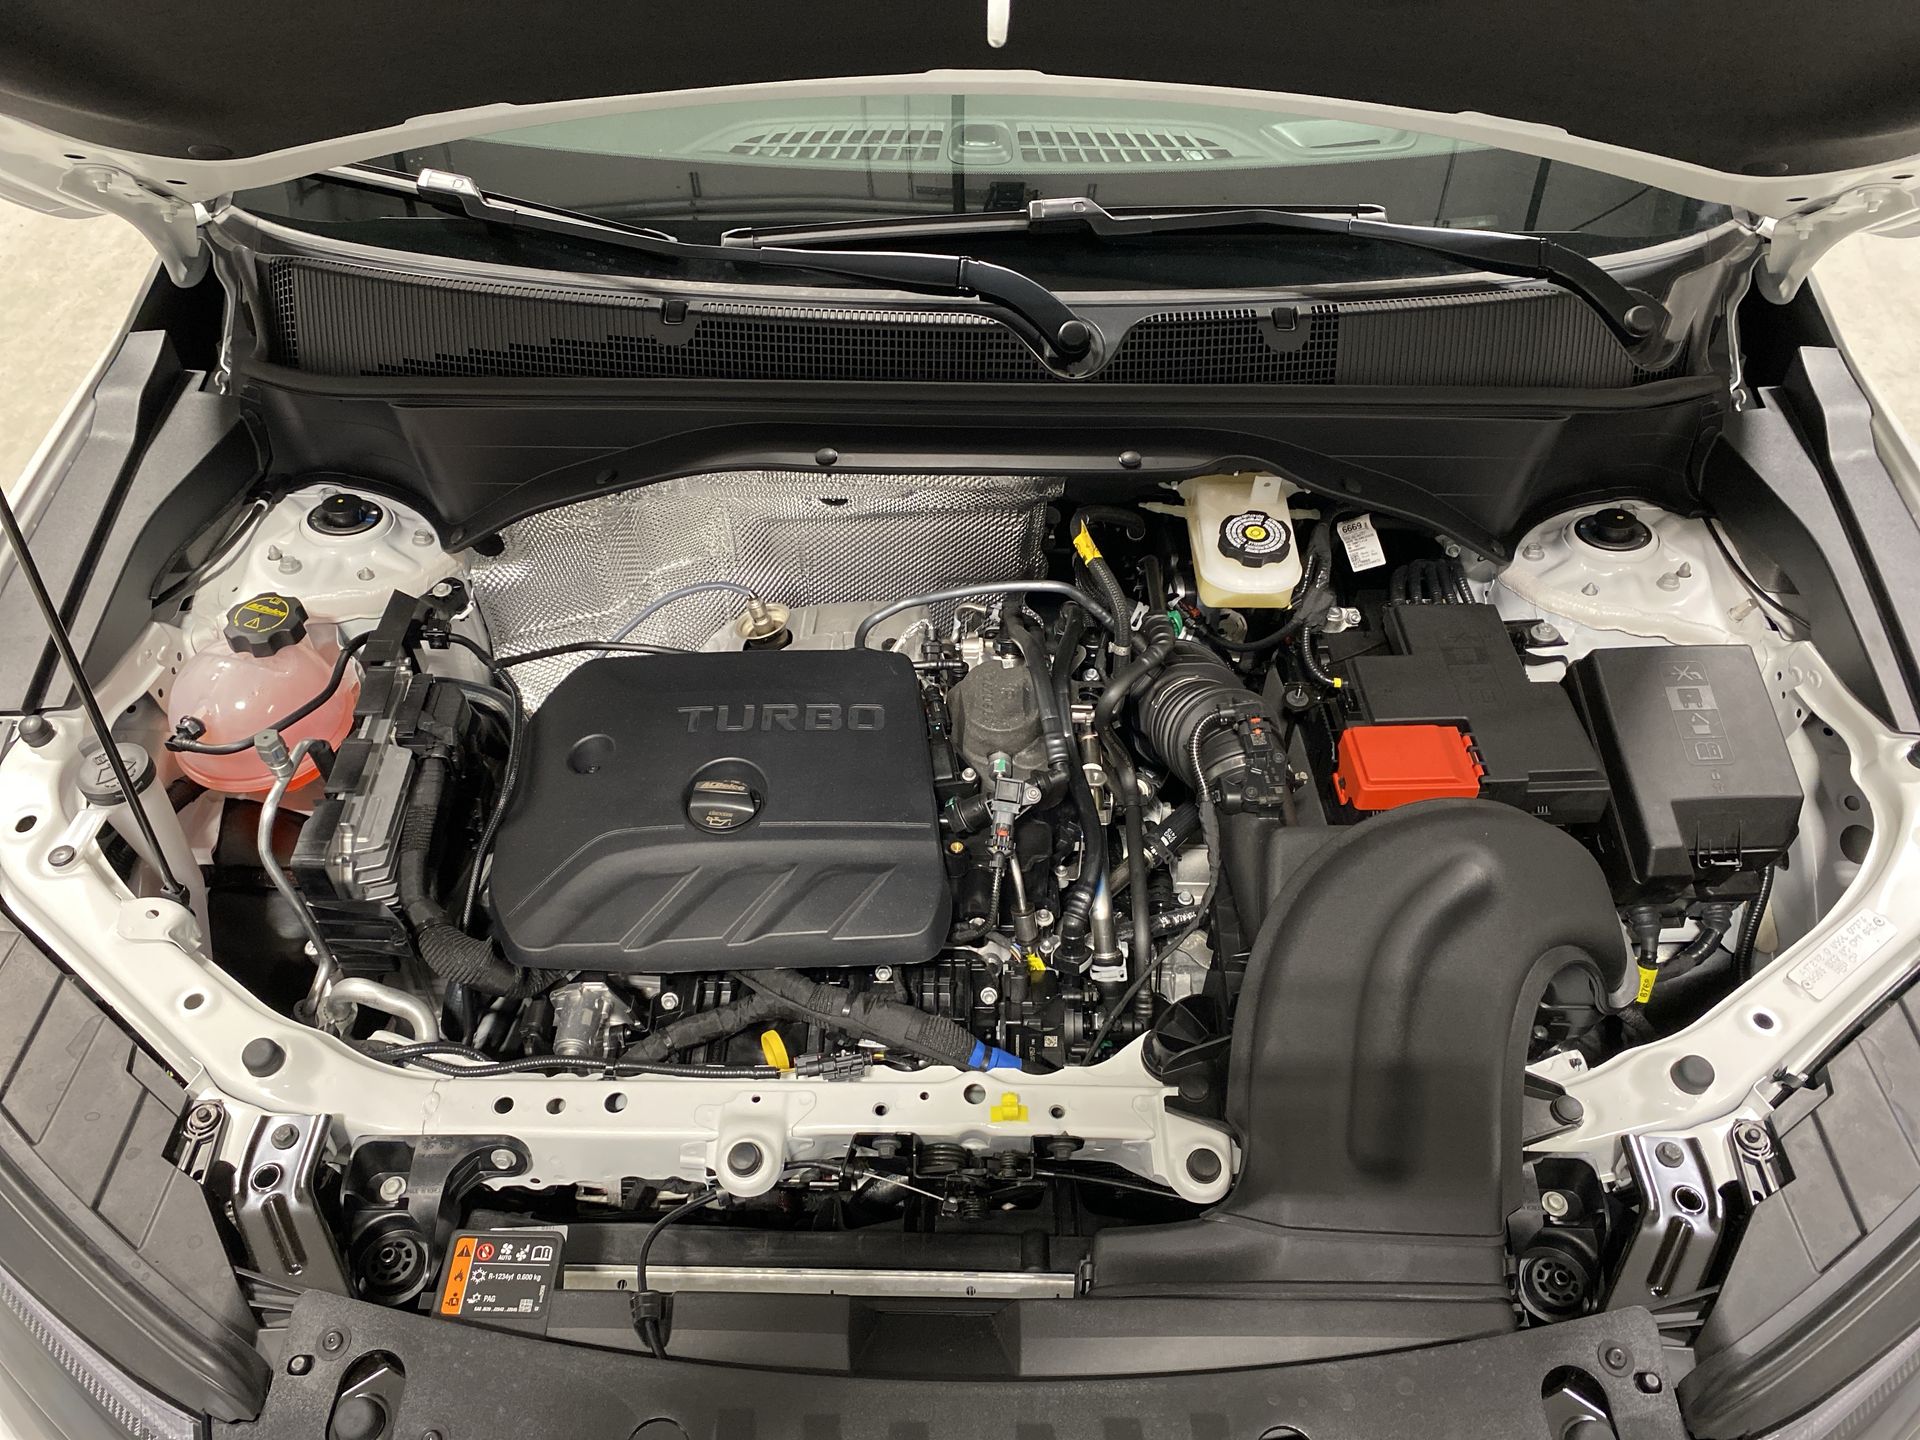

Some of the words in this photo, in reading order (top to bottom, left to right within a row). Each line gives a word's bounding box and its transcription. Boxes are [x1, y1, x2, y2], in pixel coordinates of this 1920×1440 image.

[1342, 522, 1362, 533] 6669
[678, 703, 885, 732] TURBO
[488, 1272, 514, 1281] R-1234yf
[533, 1274, 541, 1282] kg
